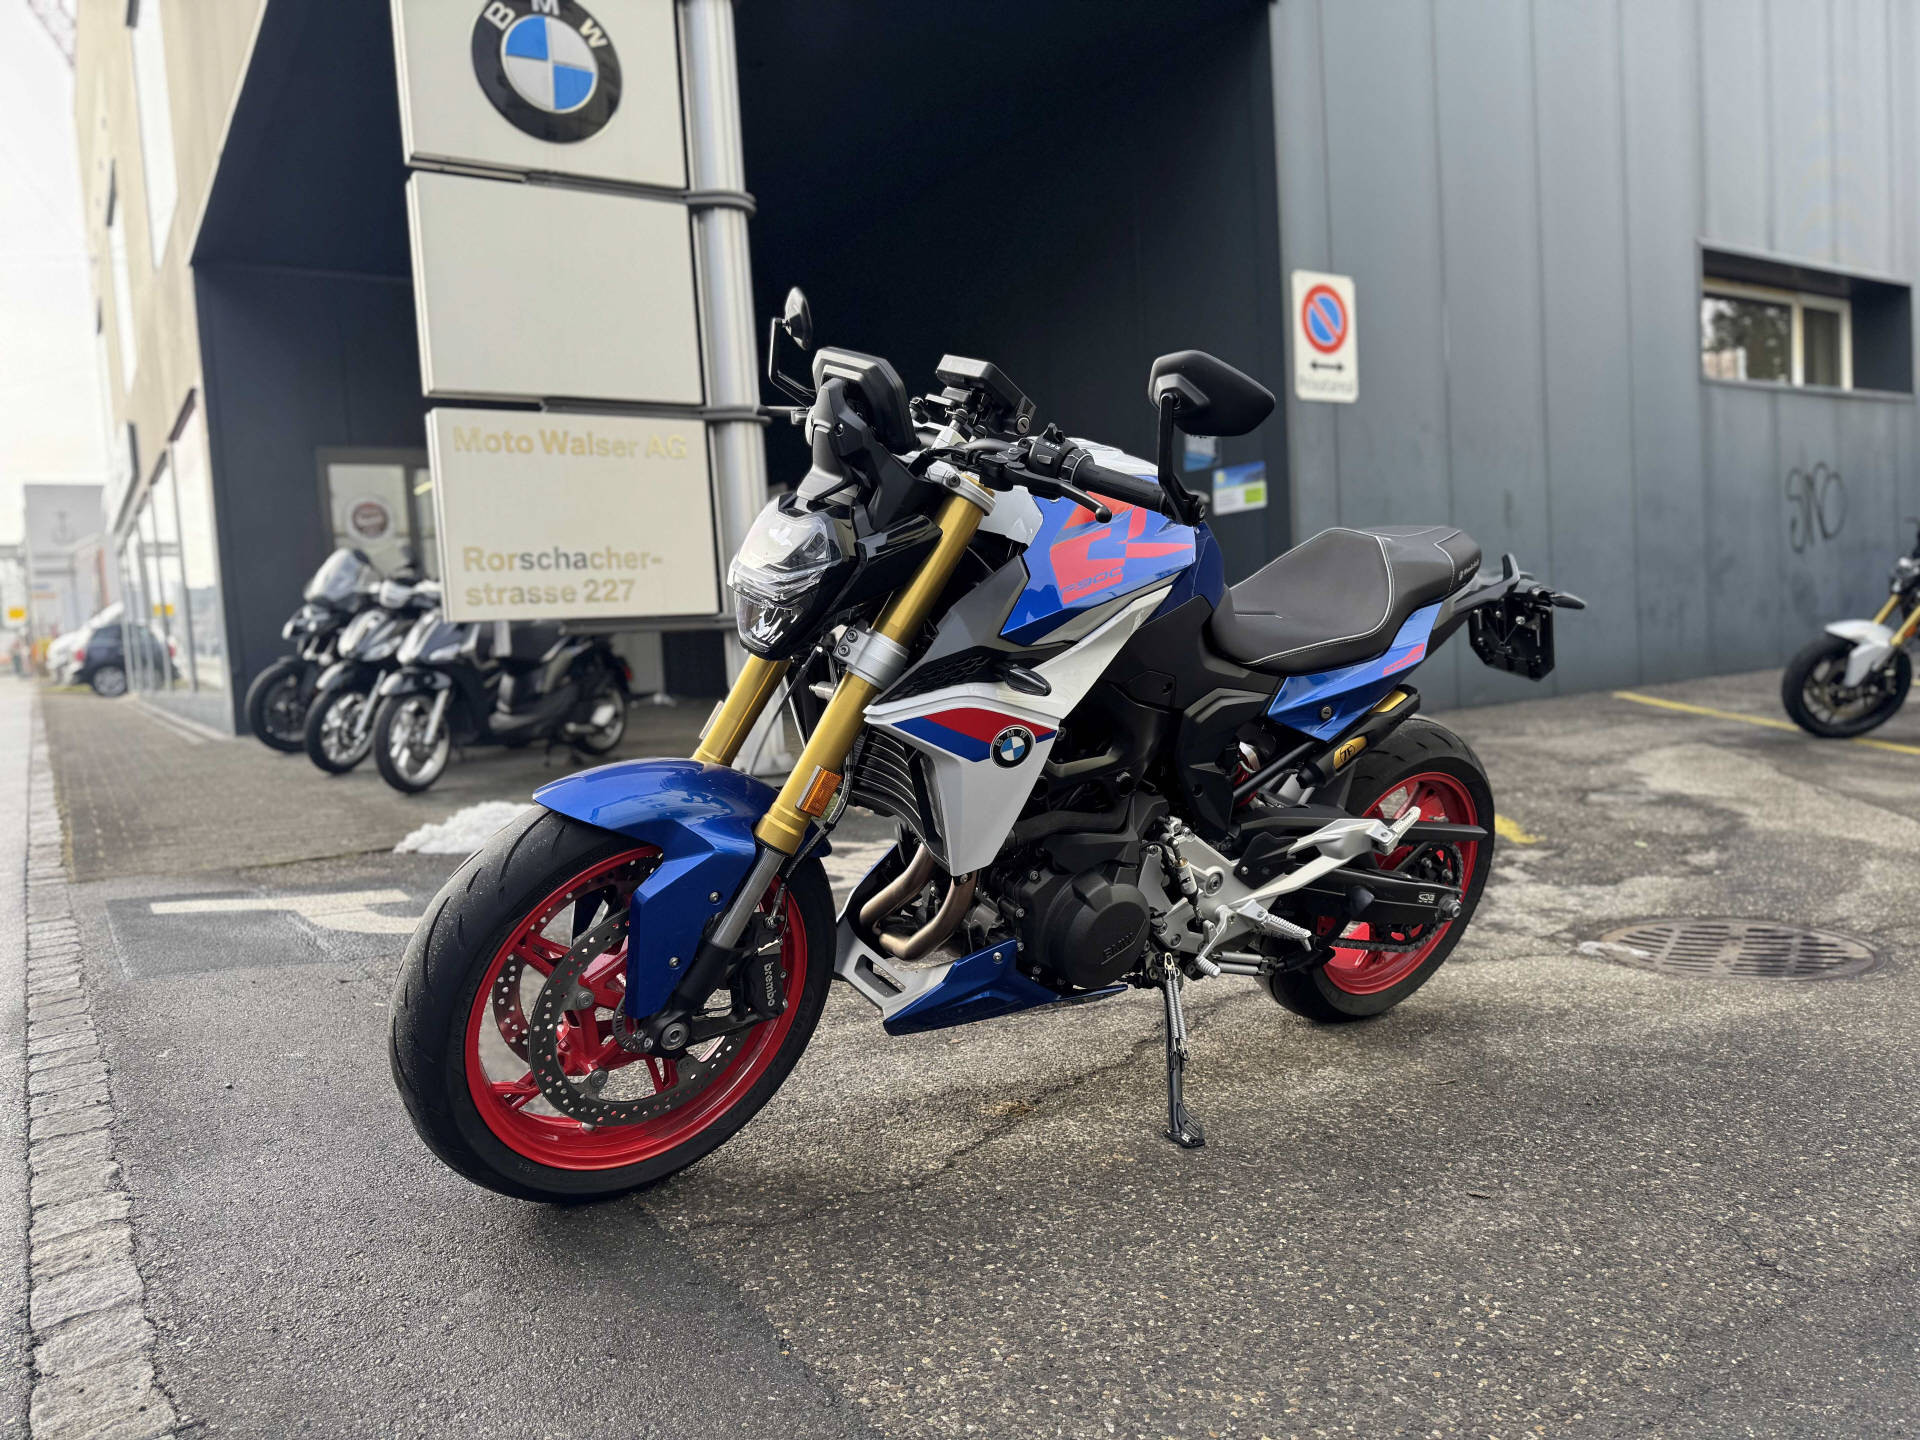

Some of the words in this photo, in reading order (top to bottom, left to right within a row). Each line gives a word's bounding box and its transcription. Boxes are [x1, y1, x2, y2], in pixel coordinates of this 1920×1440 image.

[483, 0, 608, 48] BMW
[453, 425, 535, 455] Moto
[539, 428, 639, 458] Walser
[645, 433, 688, 460] AG
[462, 545, 663, 572] Rorschacher-
[465, 581, 577, 607] strasse
[583, 578, 637, 604] 227
[994, 729, 1031, 747] BMW
[763, 961, 777, 1007] brembo
